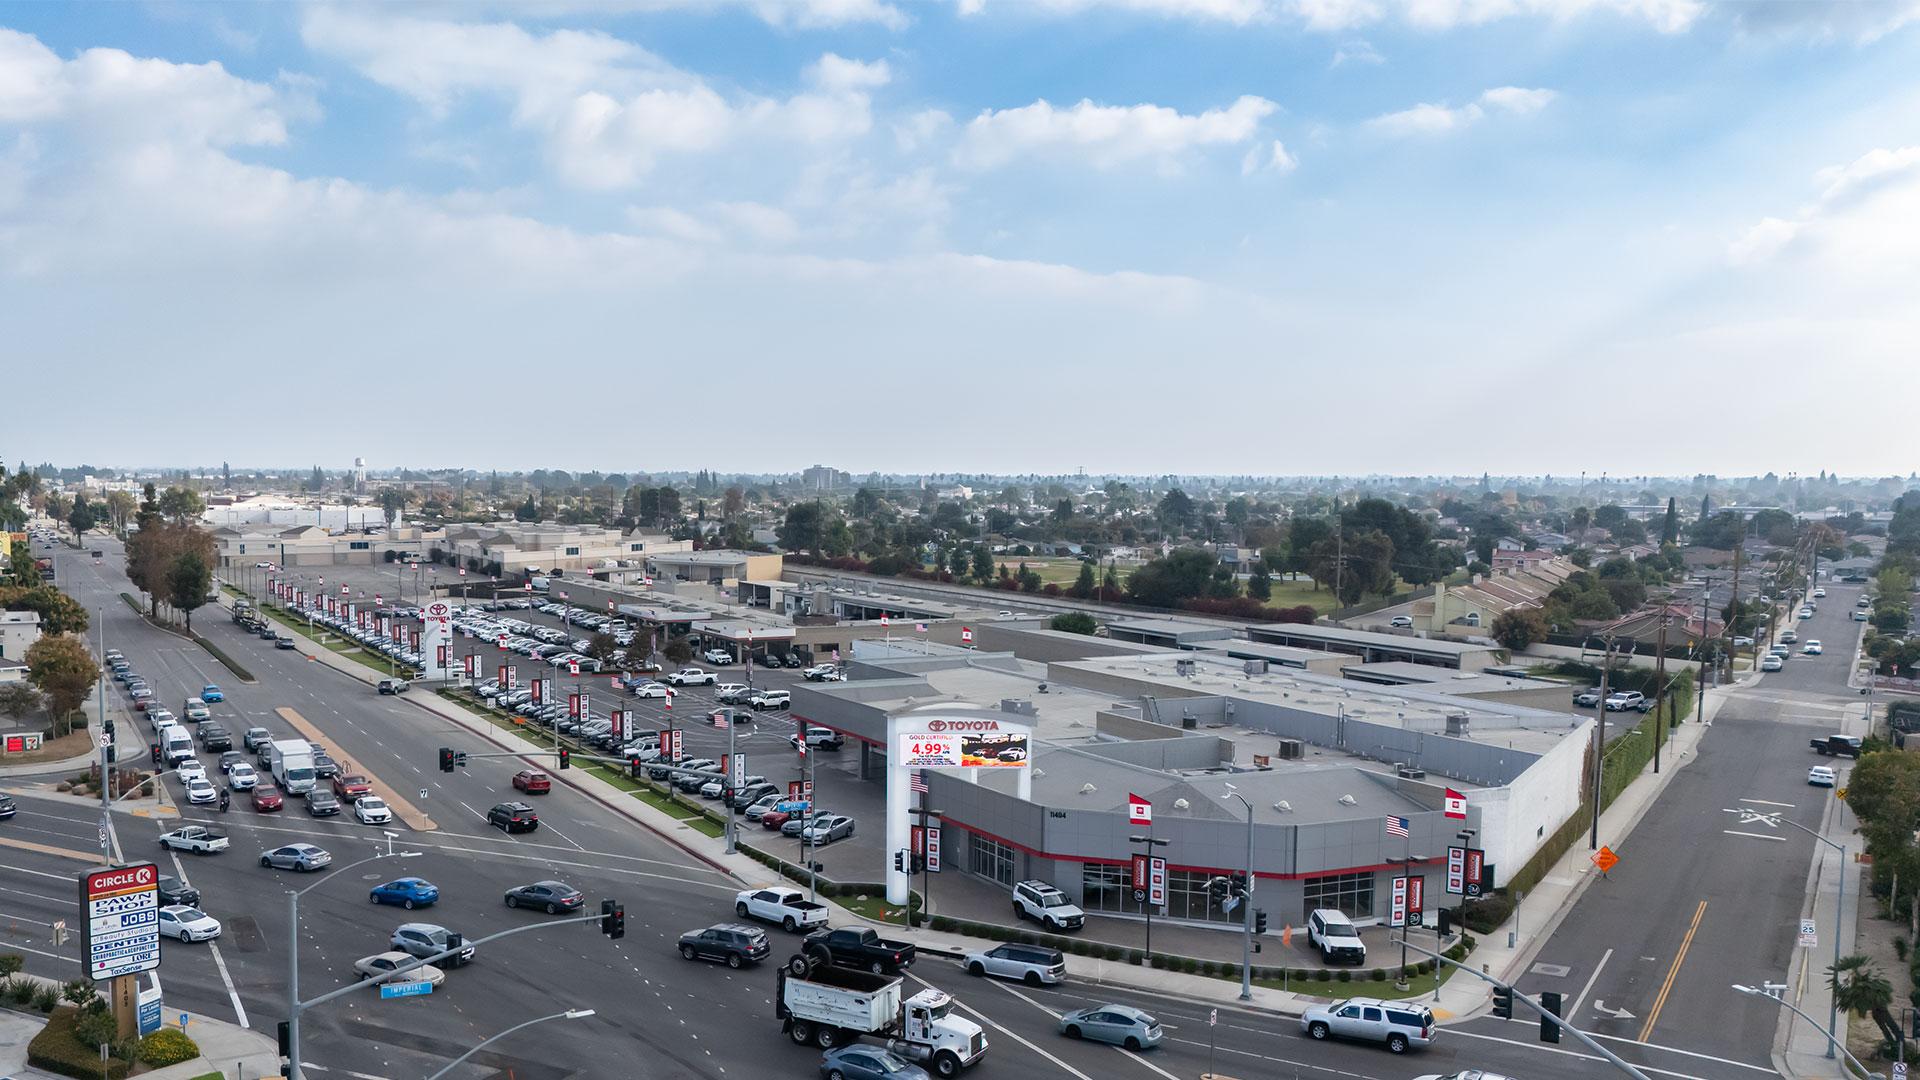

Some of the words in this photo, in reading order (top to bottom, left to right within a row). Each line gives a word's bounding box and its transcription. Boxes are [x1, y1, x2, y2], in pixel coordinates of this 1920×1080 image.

[947, 720, 999, 731] TOYOTA
[912, 743, 941, 754] 4.99
[94, 874, 134, 888] CIRCLE
[96, 892, 151, 907] PAWN
[96, 900, 151, 915] SHOP
[123, 911, 154, 926] JOBS
[100, 933, 124, 942] Beauty
[127, 927, 149, 936] Studio
[1803, 926, 1815, 934] 25
[93, 934, 156, 952] DENTIST
[111, 965, 142, 976] TaxSense
[390, 984, 422, 993] IMPERIAL
